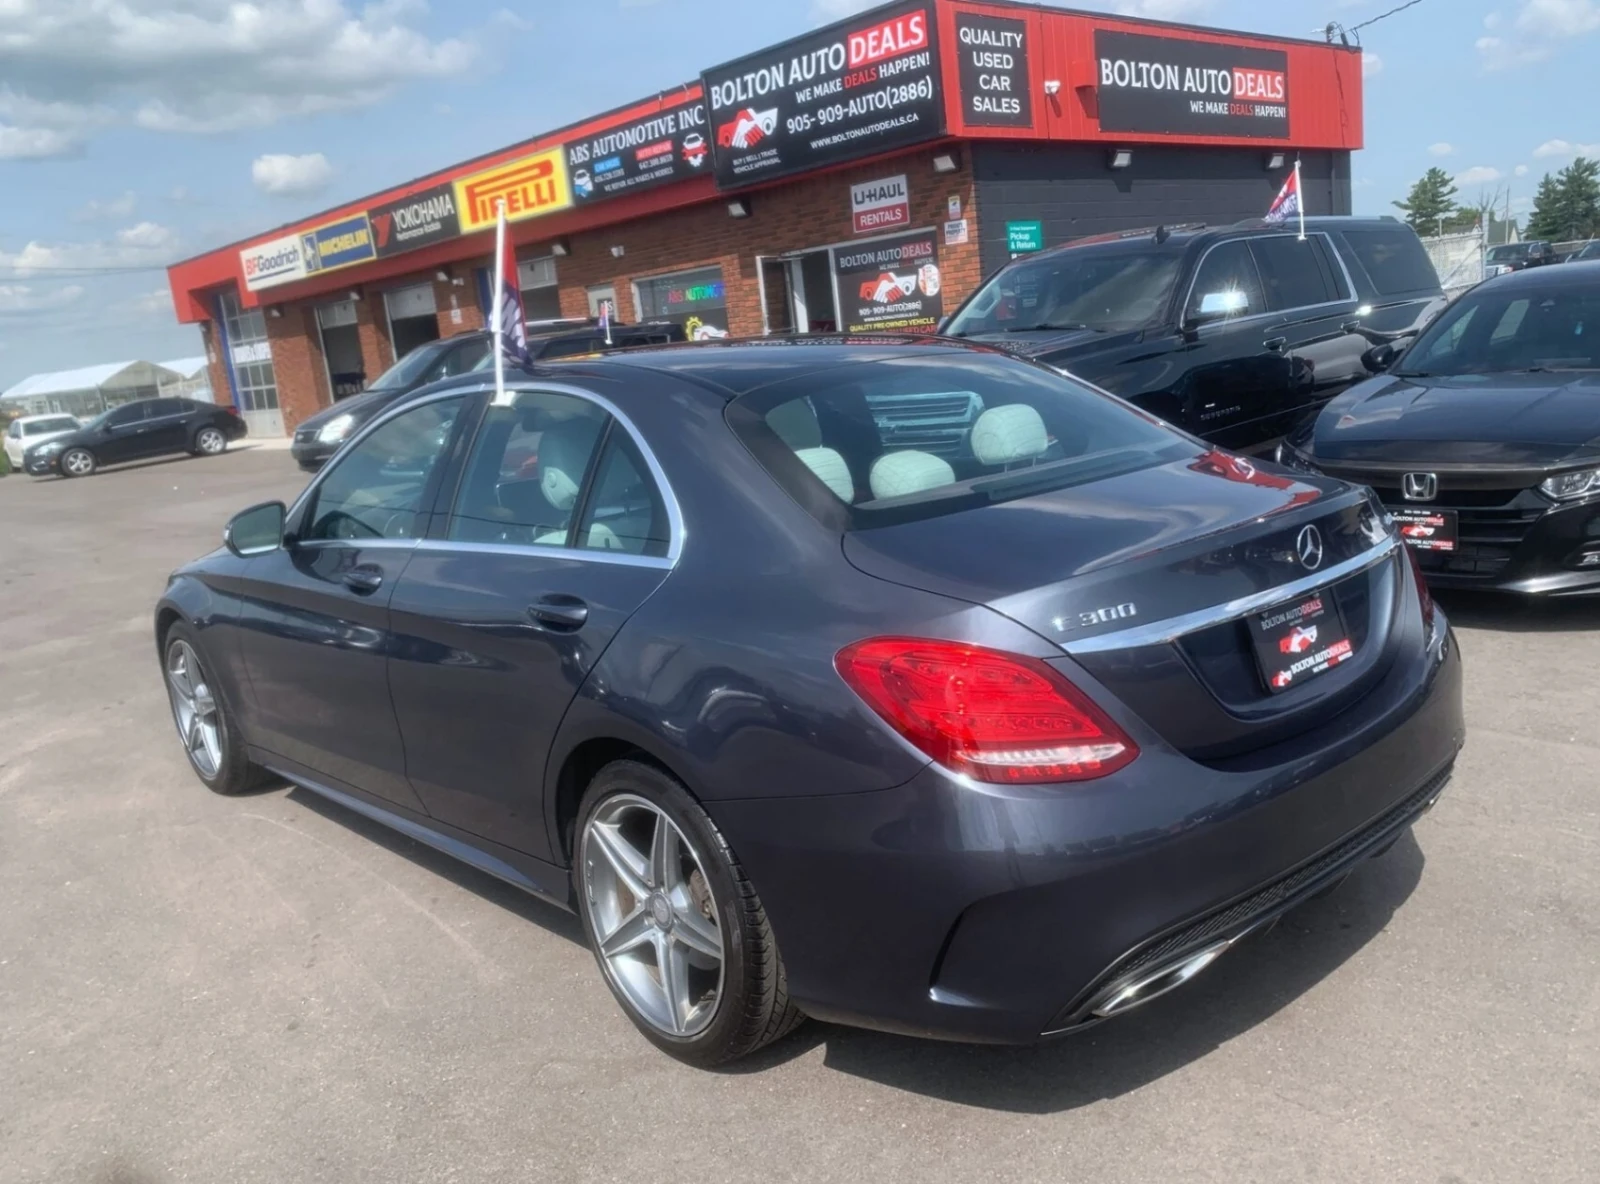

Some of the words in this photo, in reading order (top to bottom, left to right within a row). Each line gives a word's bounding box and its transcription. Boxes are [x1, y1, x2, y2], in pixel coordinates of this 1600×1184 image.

[960, 27, 1022, 48] QUALITY
[711, 63, 784, 110] BOLTON
[850, 16, 924, 64] DEALS
[973, 51, 1013, 69] USED
[796, 88, 812, 103] WE
[813, 78, 843, 98] MAKE
[844, 67, 877, 88] DEALS
[879, 52, 931, 78] HAPPEN!
[979, 74, 1011, 91] CAR
[1100, 58, 1180, 91] BOLTON
[1234, 72, 1283, 99] DEALS
[973, 96, 1020, 114] SALES
[1190, 100, 1204, 113] WE
[1205, 102, 1228, 115] MAKE
[1230, 103, 1253, 116] DEALS
[1254, 105, 1286, 118] HAPPEN!
[569, 143, 590, 166] ABS
[592, 114, 676, 158] AUTOMOTIVE
[678, 105, 705, 130] INC
[810, 113, 919, 149] WWW.BOLTONAUTODEALS.CA
[854, 183, 905, 205] U-HAUL
[392, 193, 455, 231] YOKOHAMA
[860, 208, 902, 227] RENTALS
[319, 229, 369, 257] MICHELIN
[1010, 232, 1030, 241] Pickup
[1016, 240, 1036, 249] Return
[245, 245, 300, 276] BFGoodrich
[840, 252, 875, 268] BOLTON
[902, 242, 932, 258] DEALS
[849, 323, 873, 332] QUALITY
[908, 317, 935, 326] VEHICLE
[1079, 602, 1136, 627] 300
[1261, 612, 1285, 631] BOLTON
[1290, 655, 1315, 674] BOLTON
